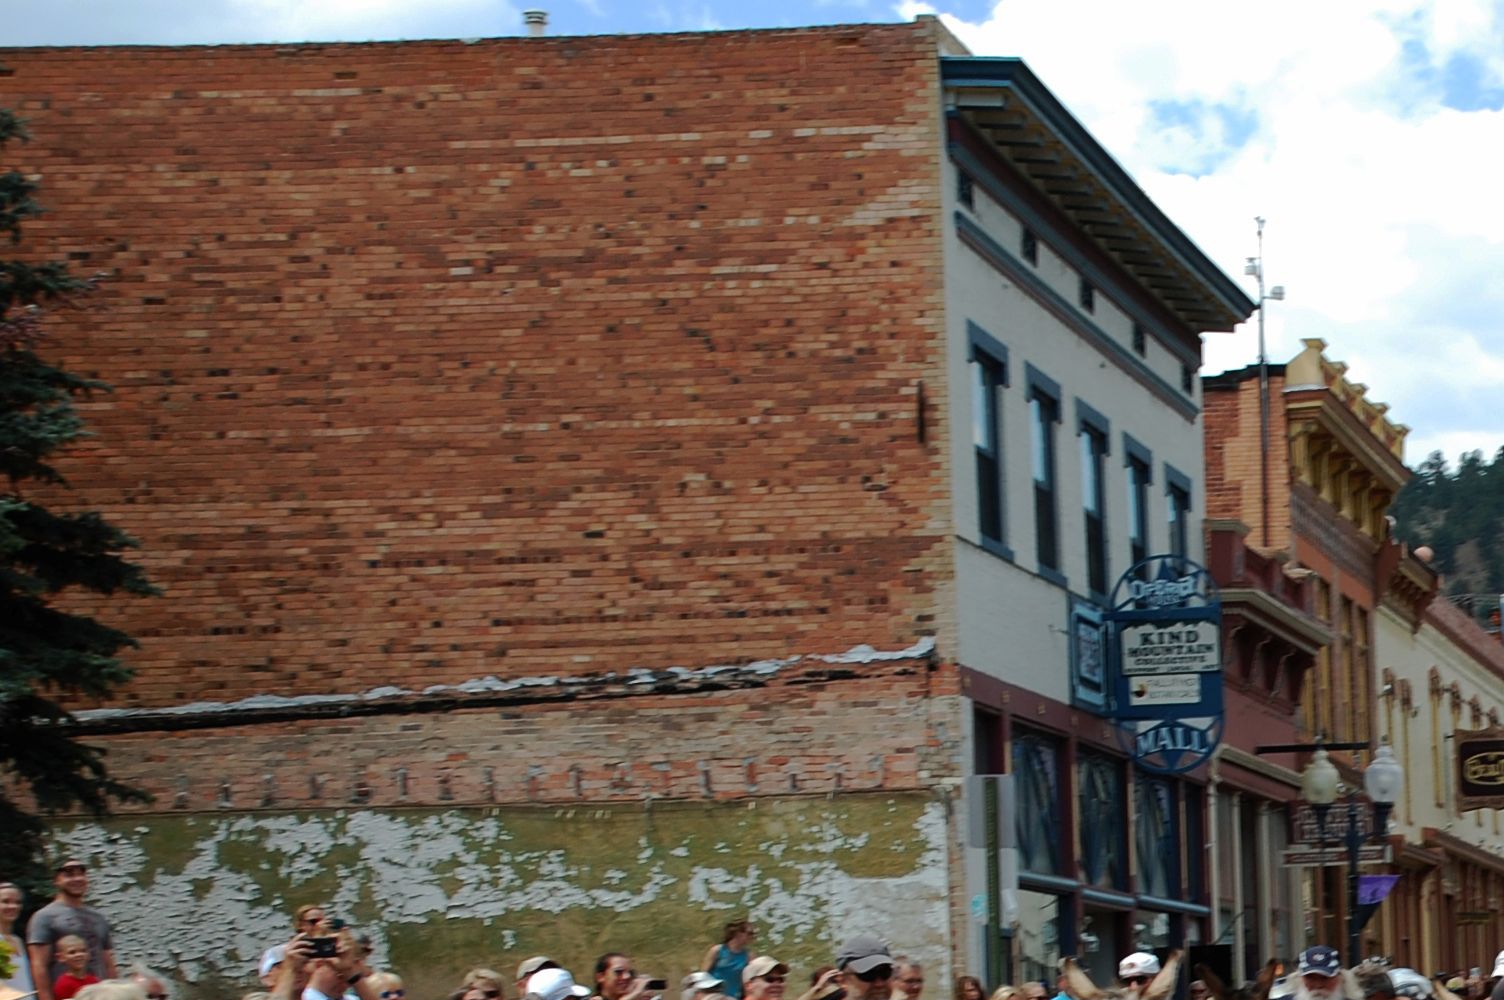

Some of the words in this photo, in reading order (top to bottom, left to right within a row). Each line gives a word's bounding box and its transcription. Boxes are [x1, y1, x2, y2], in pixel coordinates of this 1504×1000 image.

[1140, 629, 1199, 646] KIND
[1127, 643, 1214, 657] MOUNTAIN
[1136, 726, 1209, 758] MALL
